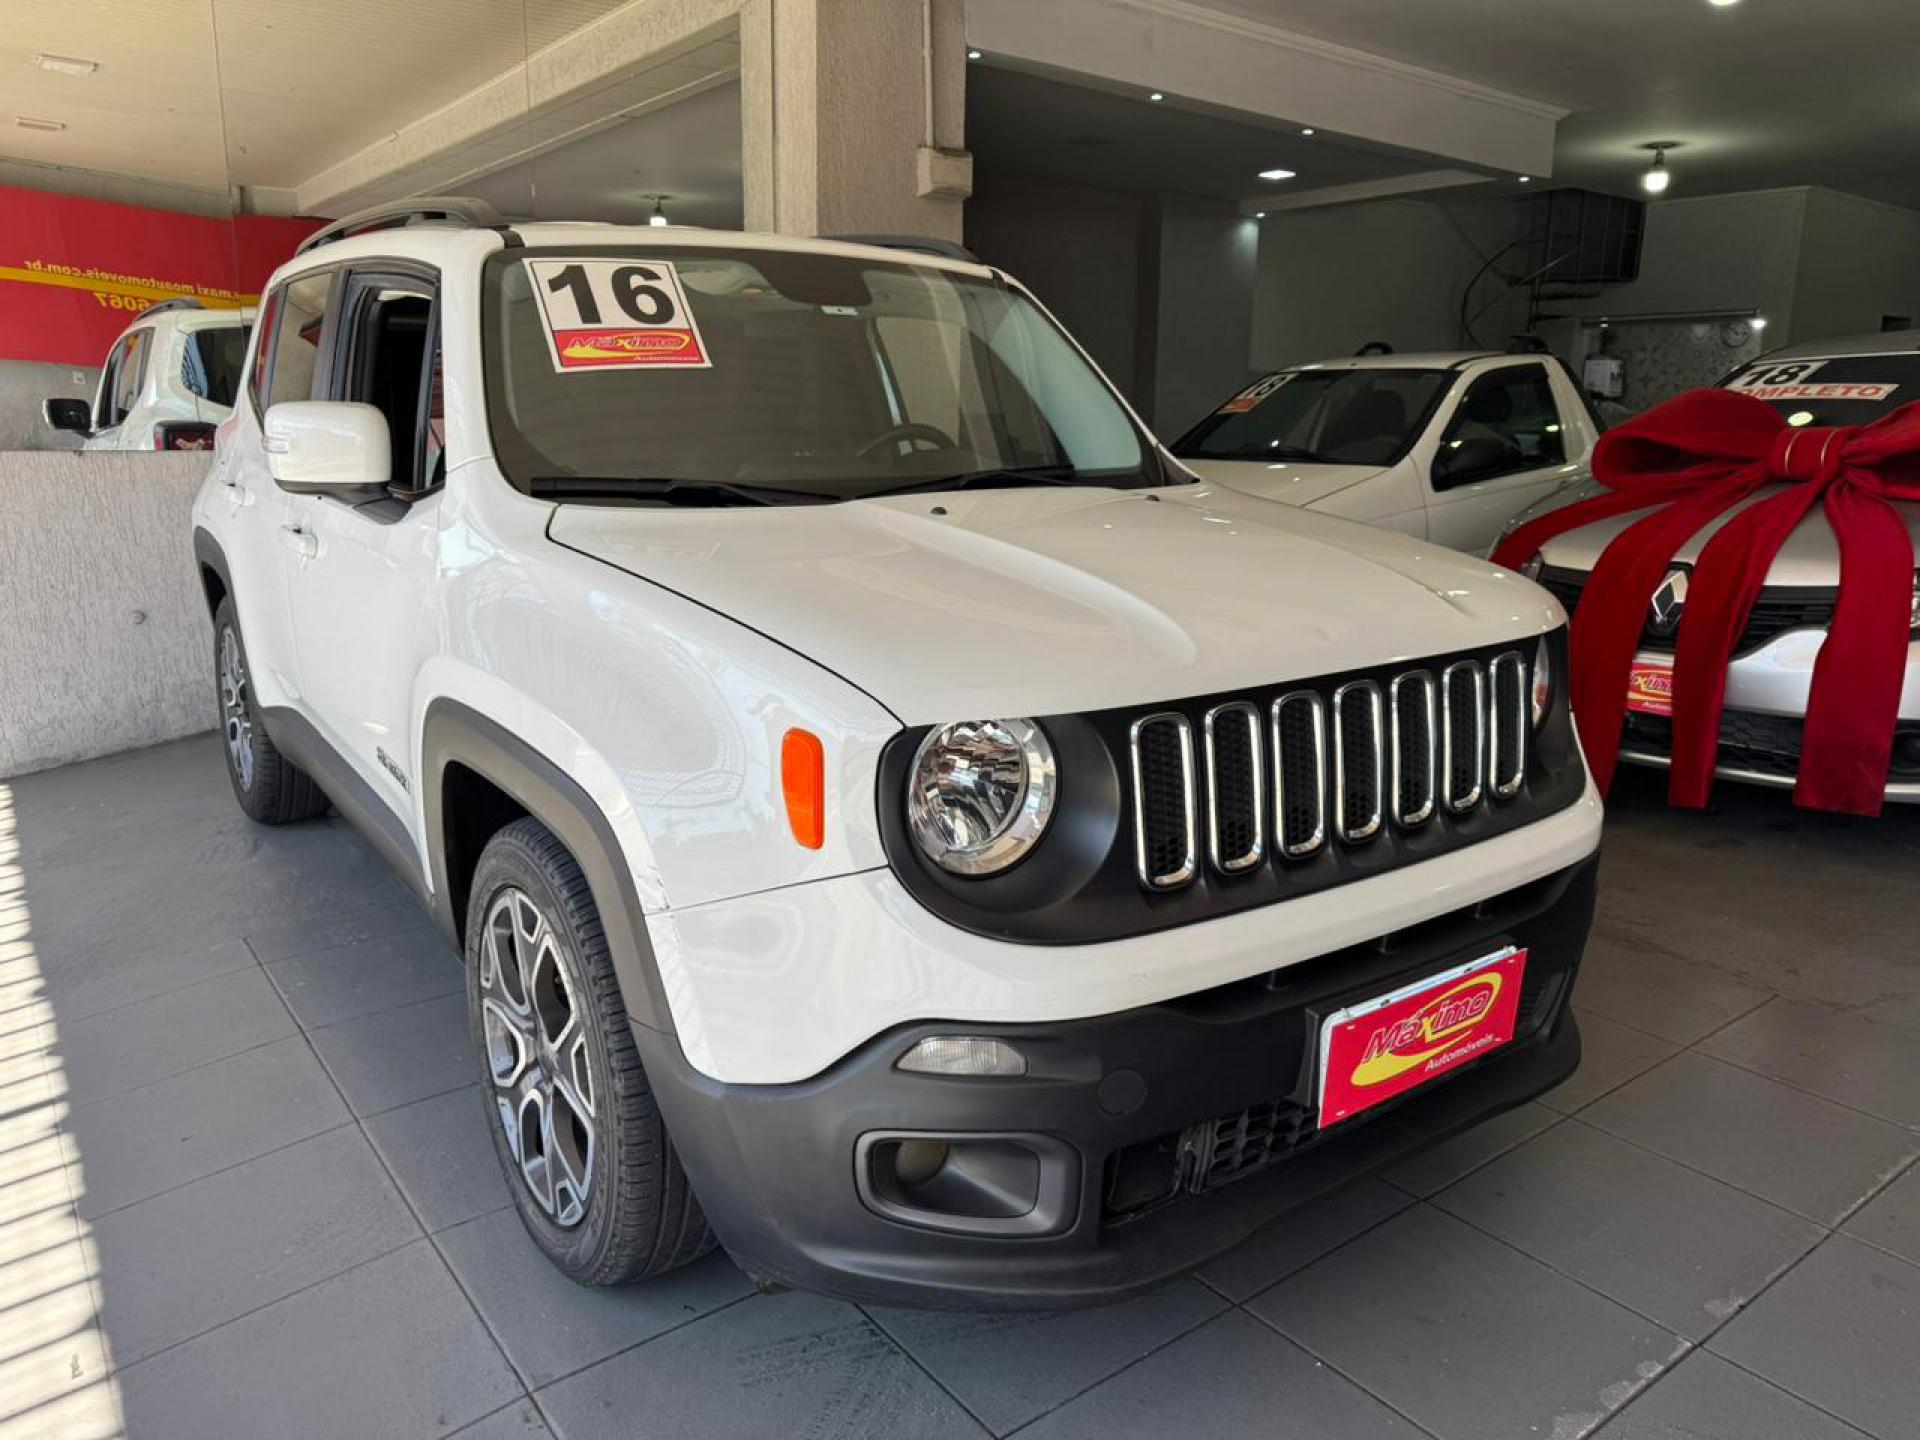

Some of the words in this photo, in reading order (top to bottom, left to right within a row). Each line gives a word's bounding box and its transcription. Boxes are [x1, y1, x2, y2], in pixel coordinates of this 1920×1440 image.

[548, 264, 676, 325] 16
[1742, 364, 1812, 386] 18
[1742, 386, 1883, 398] OMPLETO
